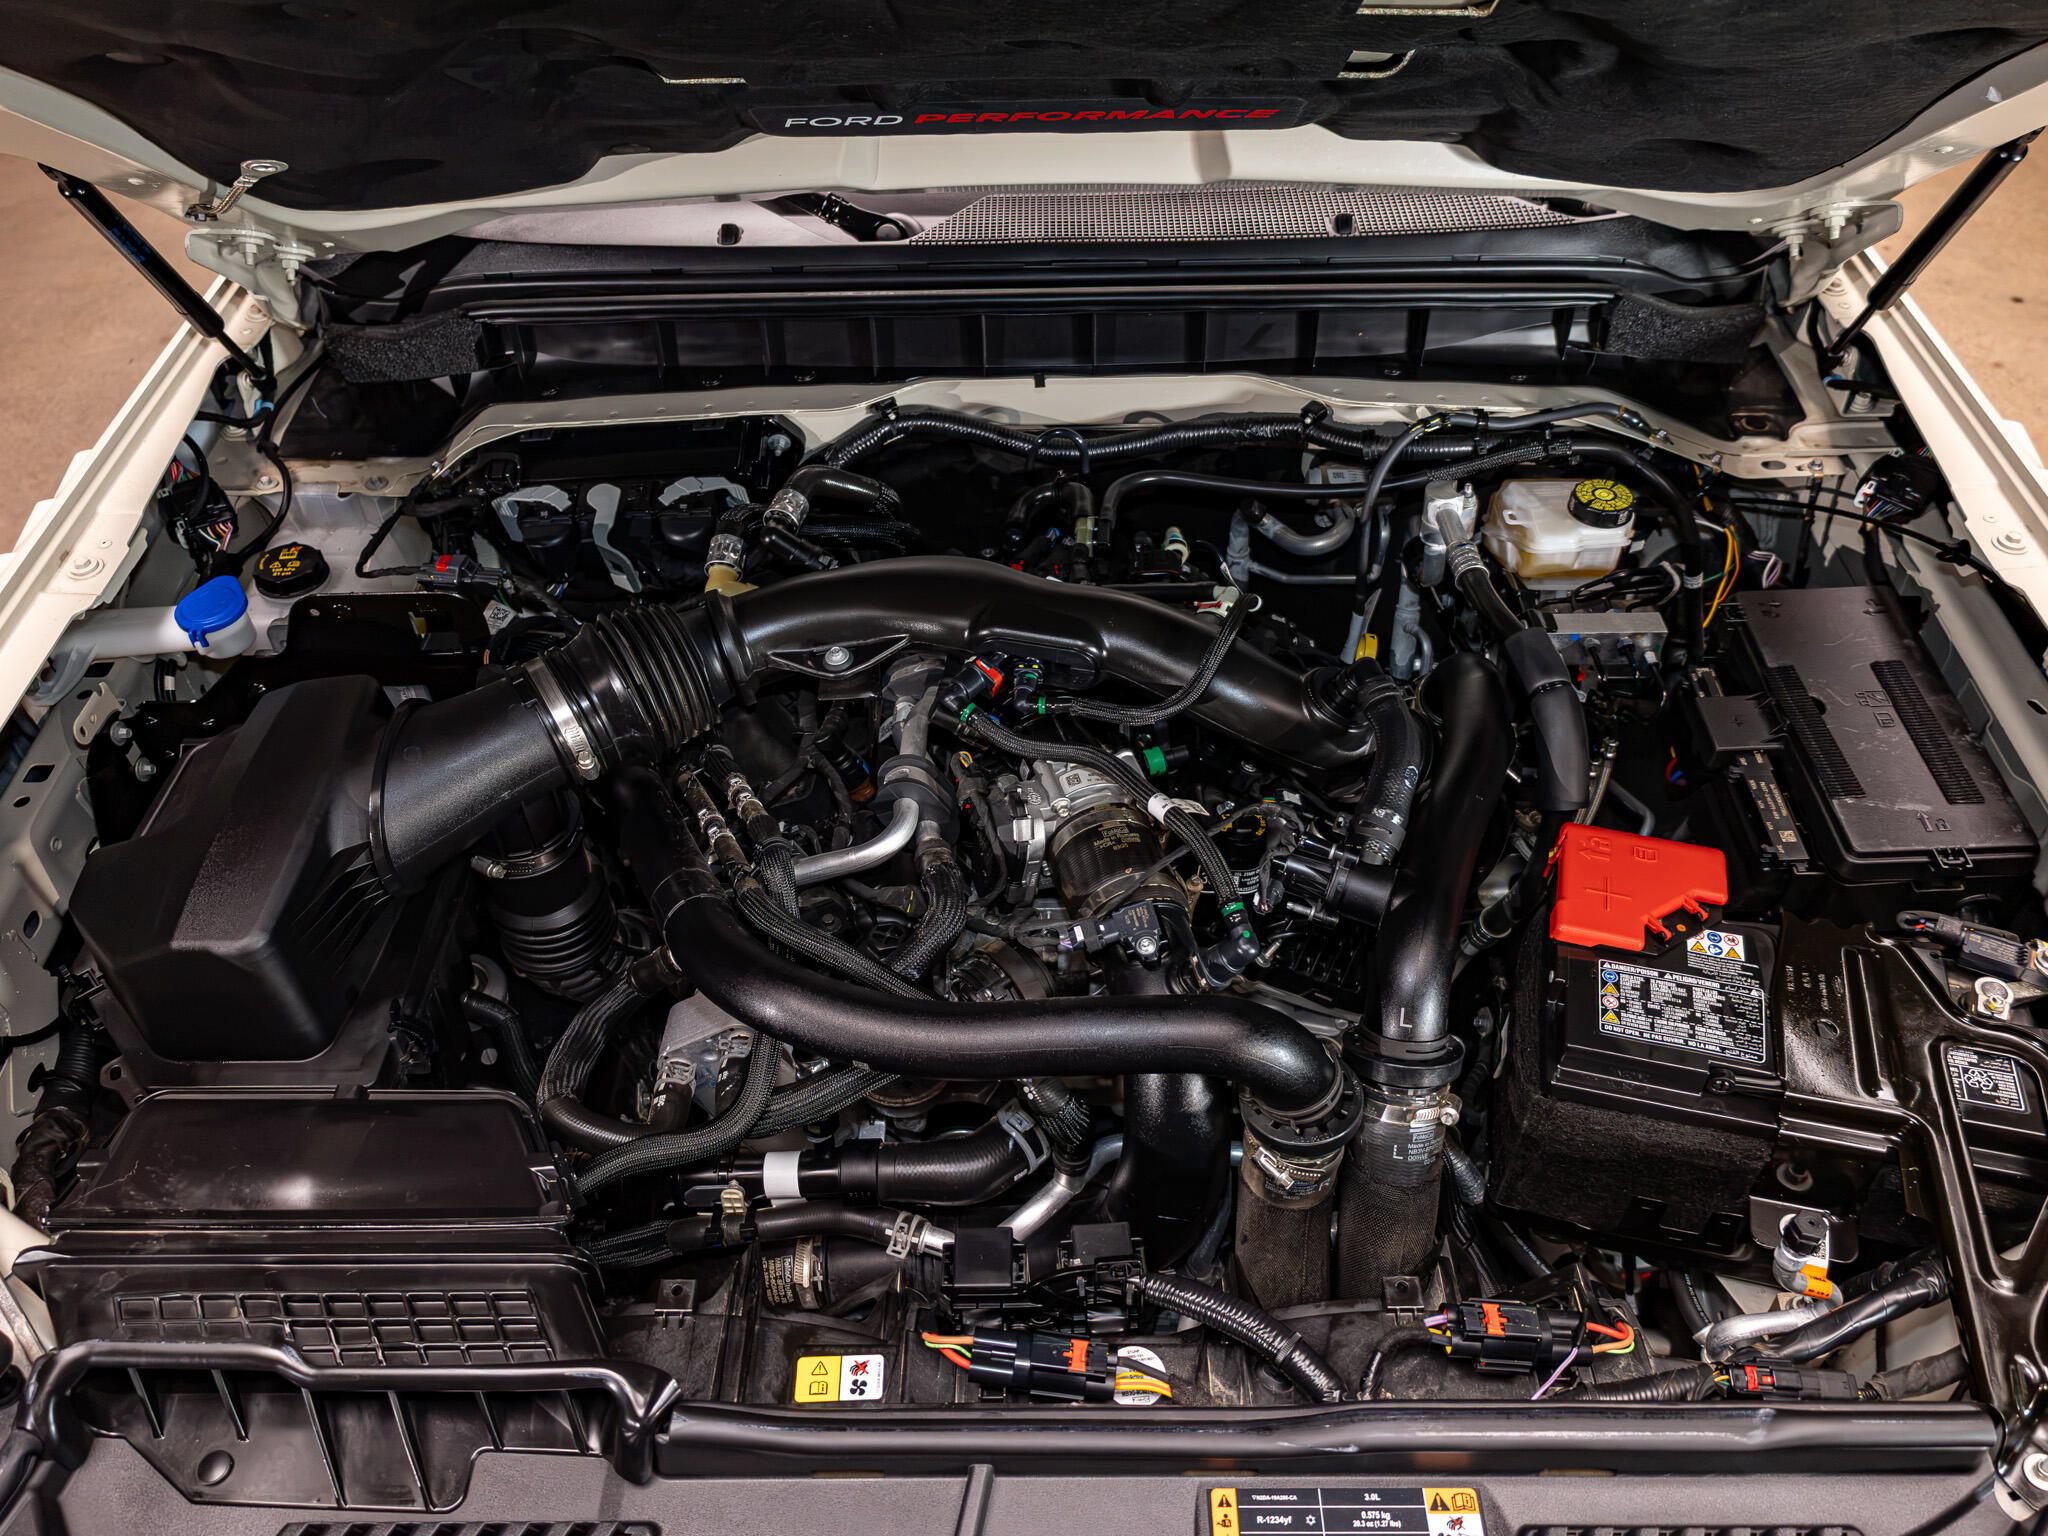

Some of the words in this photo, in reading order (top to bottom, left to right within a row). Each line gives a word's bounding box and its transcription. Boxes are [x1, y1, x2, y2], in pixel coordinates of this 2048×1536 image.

[785, 114, 903, 129] FORD
[914, 108, 1281, 126] PERFORMANCE
[1611, 964, 1659, 977] DANGER/POISON
[1672, 974, 1720, 988] PELIGRO/VENENO
[1400, 1008, 1412, 1028] L
[1614, 1026, 1625, 1034] NOT
[1651, 1033, 1662, 1041] PAS
[1393, 1144, 1404, 1160] L
[1256, 1516, 1292, 1526] R-1234yf
[1361, 1511, 1380, 1519] 0.575
[1381, 1511, 1391, 1520] kg
[1374, 1520, 1388, 1528] (1.27
[1389, 1520, 1402, 1528] lbs)
